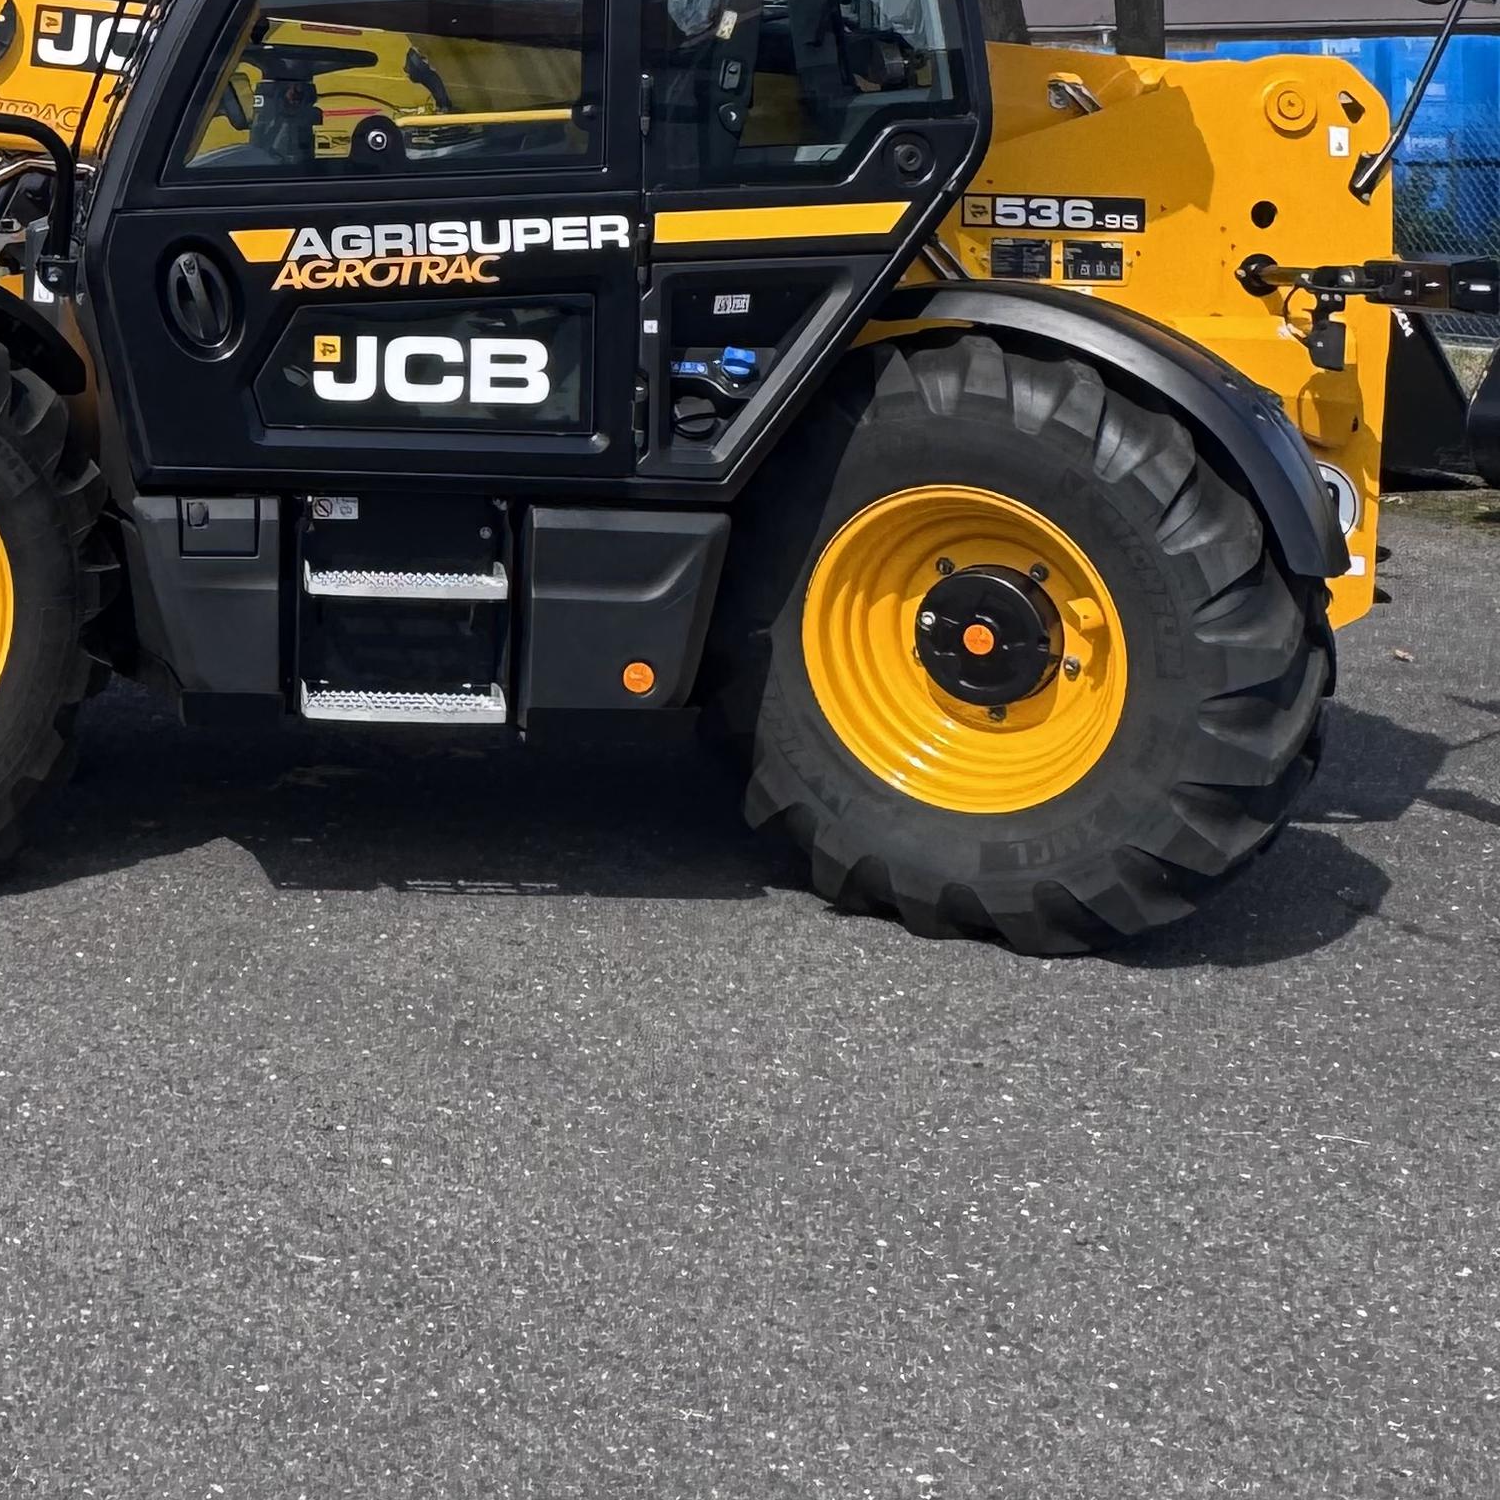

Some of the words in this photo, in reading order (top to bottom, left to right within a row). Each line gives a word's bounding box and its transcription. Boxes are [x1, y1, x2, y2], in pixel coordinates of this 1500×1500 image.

[37, 13, 156, 72] JC
[287, 215, 630, 260] AGRISUPER
[271, 254, 500, 290] AGROTRAC
[313, 336, 550, 404] JCB
